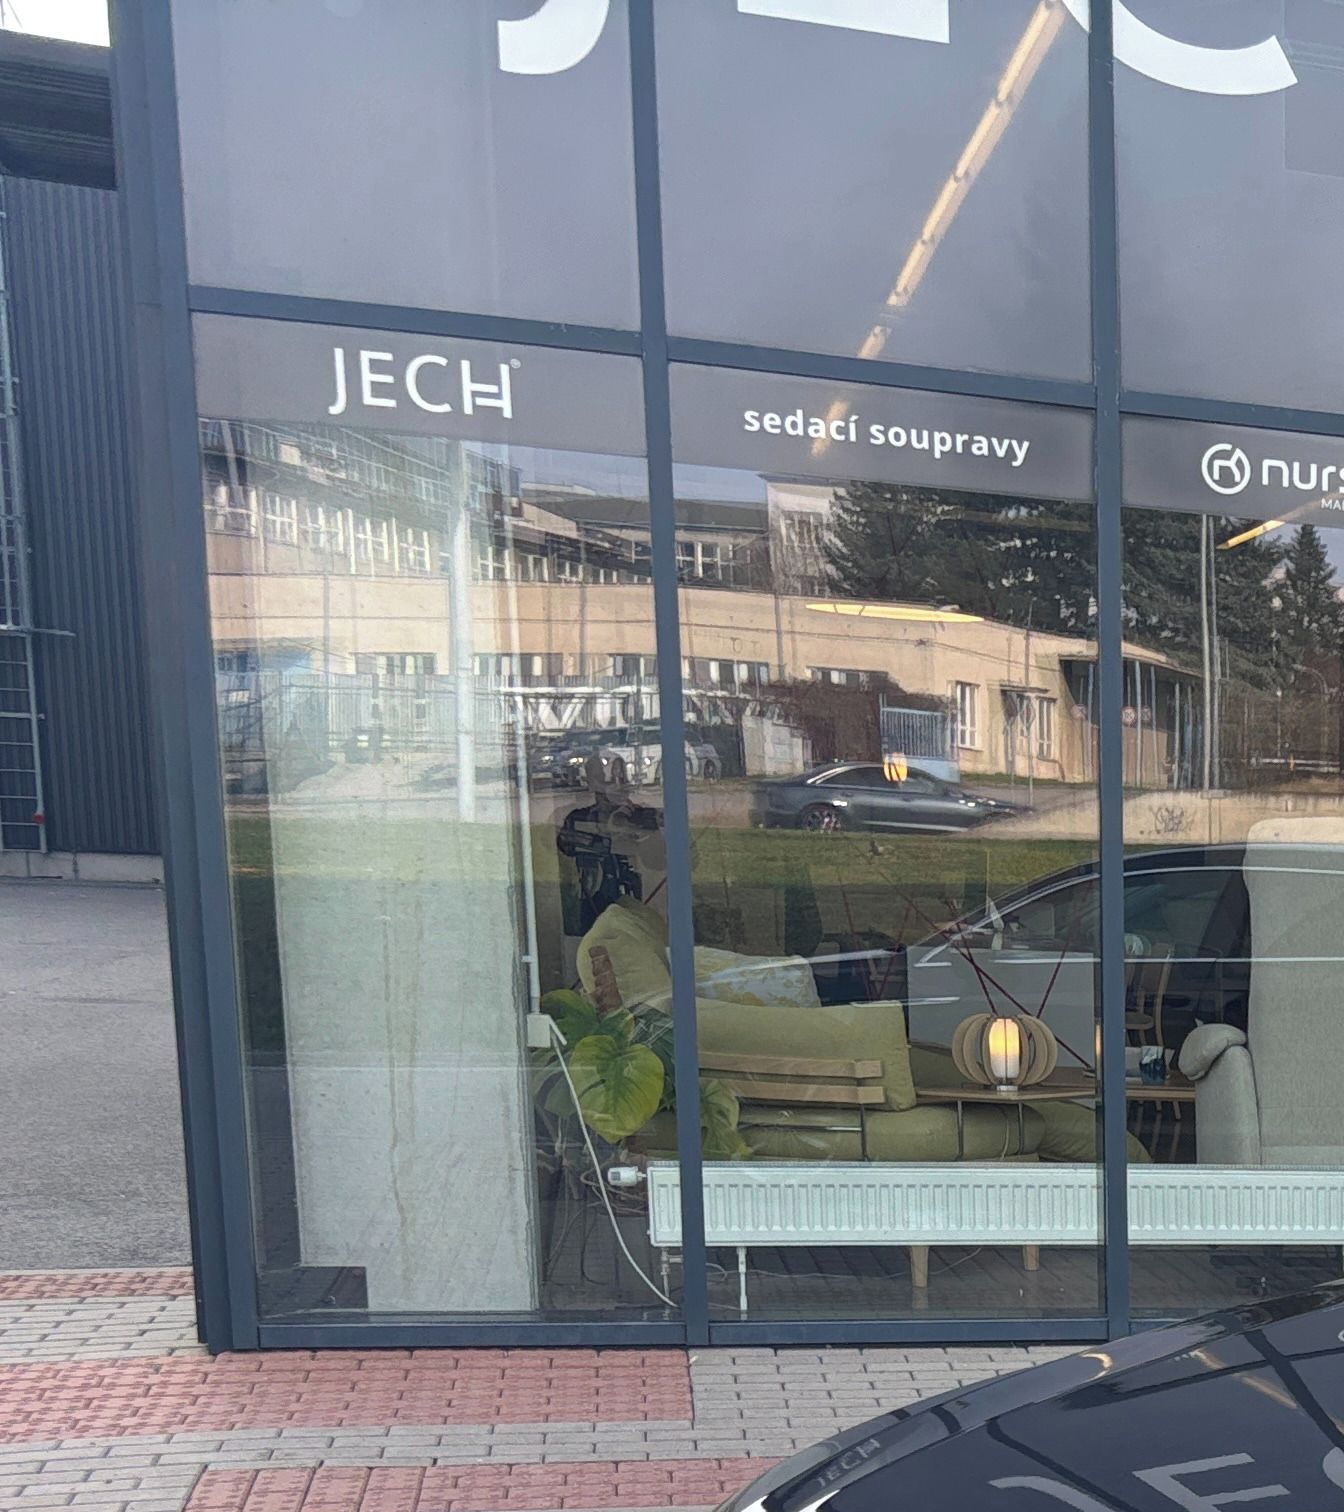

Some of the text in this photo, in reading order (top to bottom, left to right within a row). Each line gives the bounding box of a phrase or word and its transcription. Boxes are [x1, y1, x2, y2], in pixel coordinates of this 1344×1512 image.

[328, 347, 513, 419] JECH
[743, 409, 1030, 467] sedací soupravy
